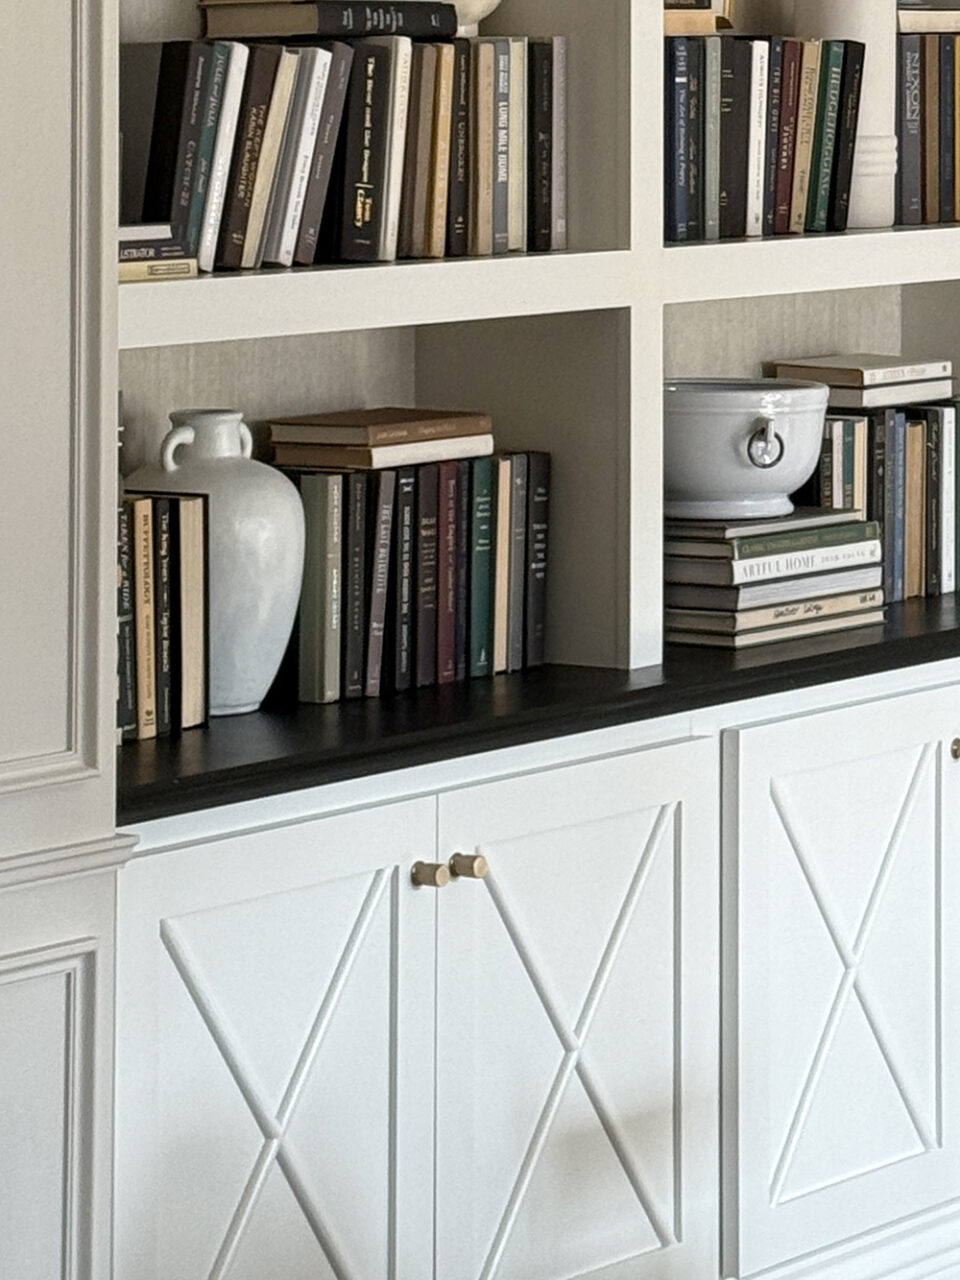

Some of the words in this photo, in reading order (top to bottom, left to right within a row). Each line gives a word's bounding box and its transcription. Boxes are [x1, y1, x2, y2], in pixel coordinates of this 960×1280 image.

[911, 52, 920, 120] NIXON
[819, 66, 842, 197] HEDGEHOGGING
[236, 139, 252, 199] SLAUGHTER
[141, 513, 151, 605] BUFFETTOLOGY
[742, 559, 783, 579] ARTFUL
[785, 554, 816, 571] HOME
